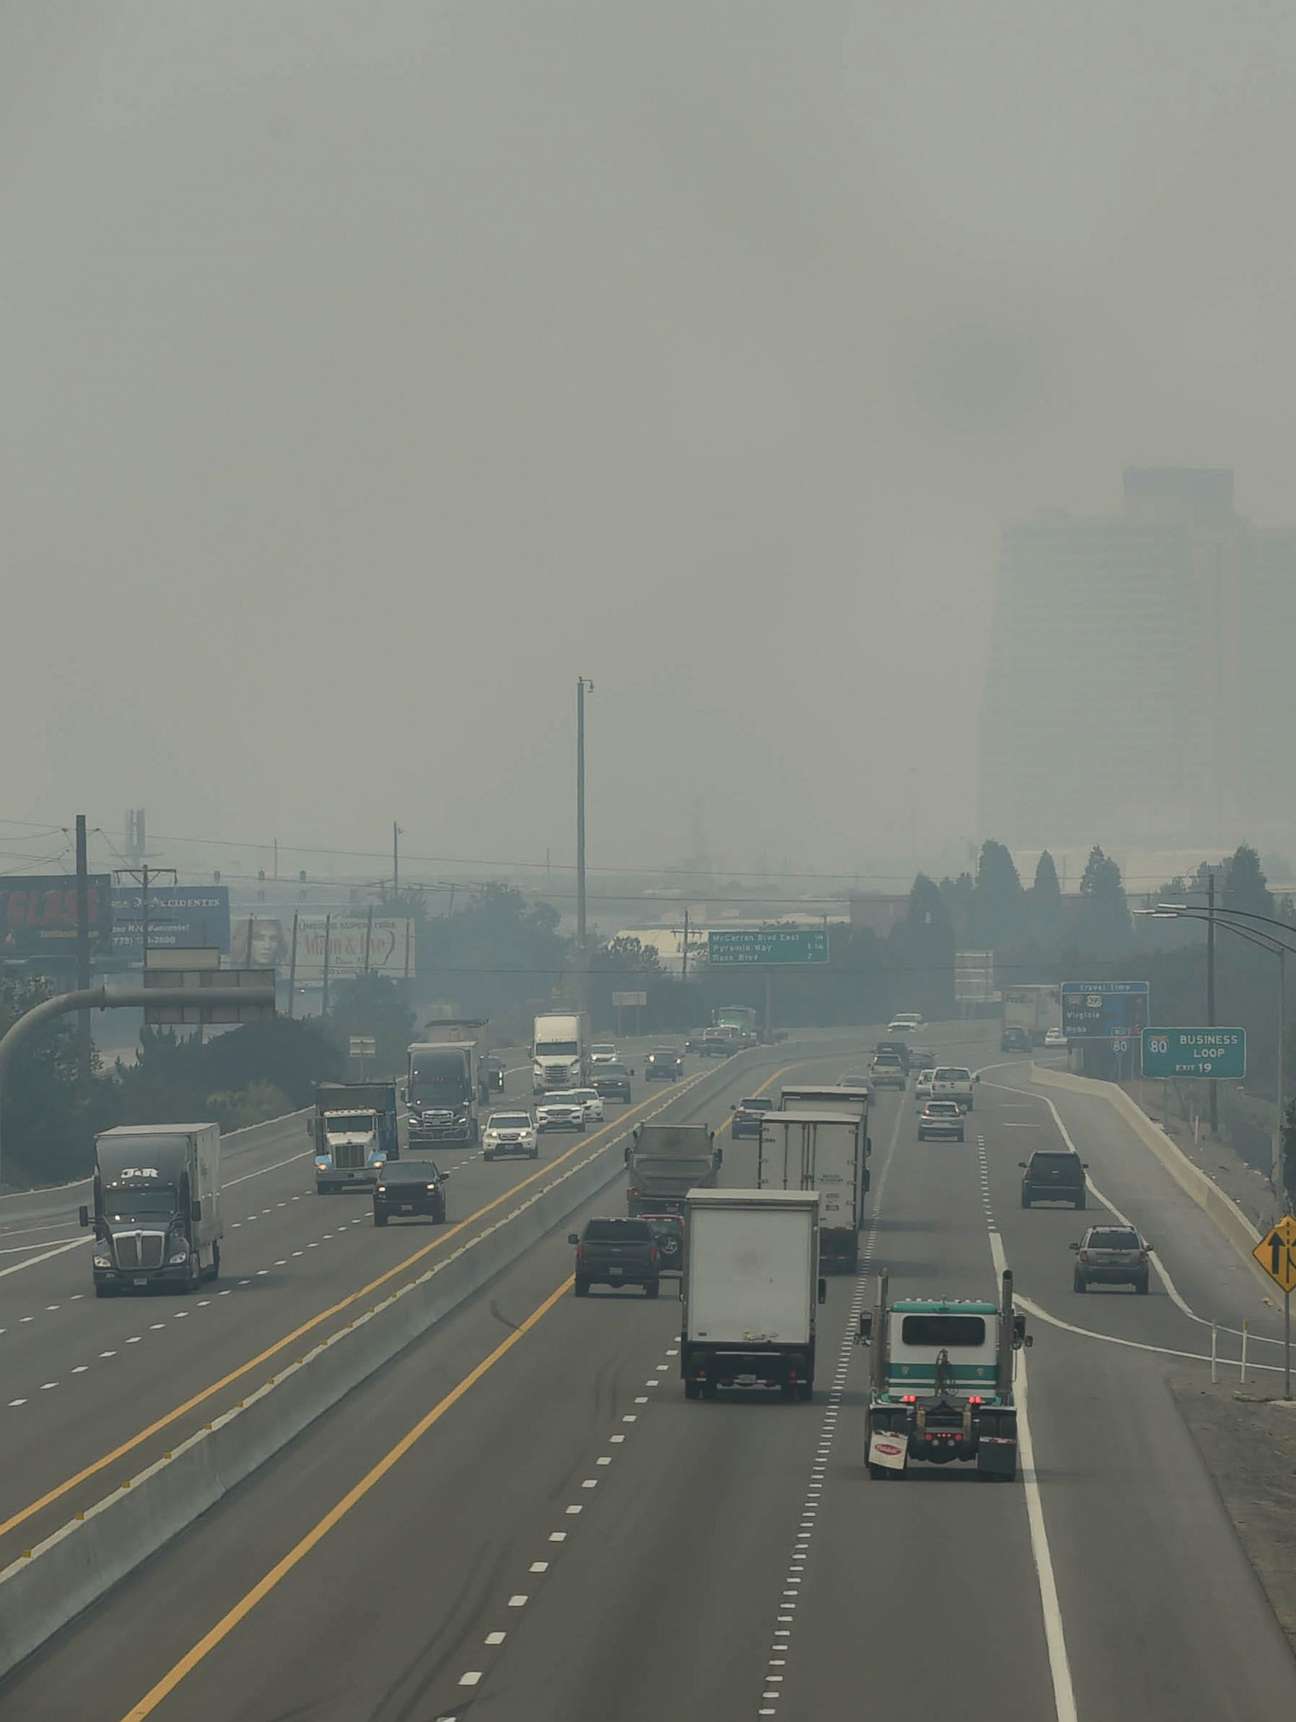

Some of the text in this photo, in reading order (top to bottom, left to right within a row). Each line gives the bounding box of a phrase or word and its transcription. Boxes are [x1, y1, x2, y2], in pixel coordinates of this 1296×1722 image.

[1180, 1034, 1238, 1045] BUSINESS
[1113, 1041, 1127, 1052] 80
[1151, 1041, 1168, 1053] 80
[1193, 1048, 1225, 1058] LOOP
[1198, 1063, 1212, 1072] 19
